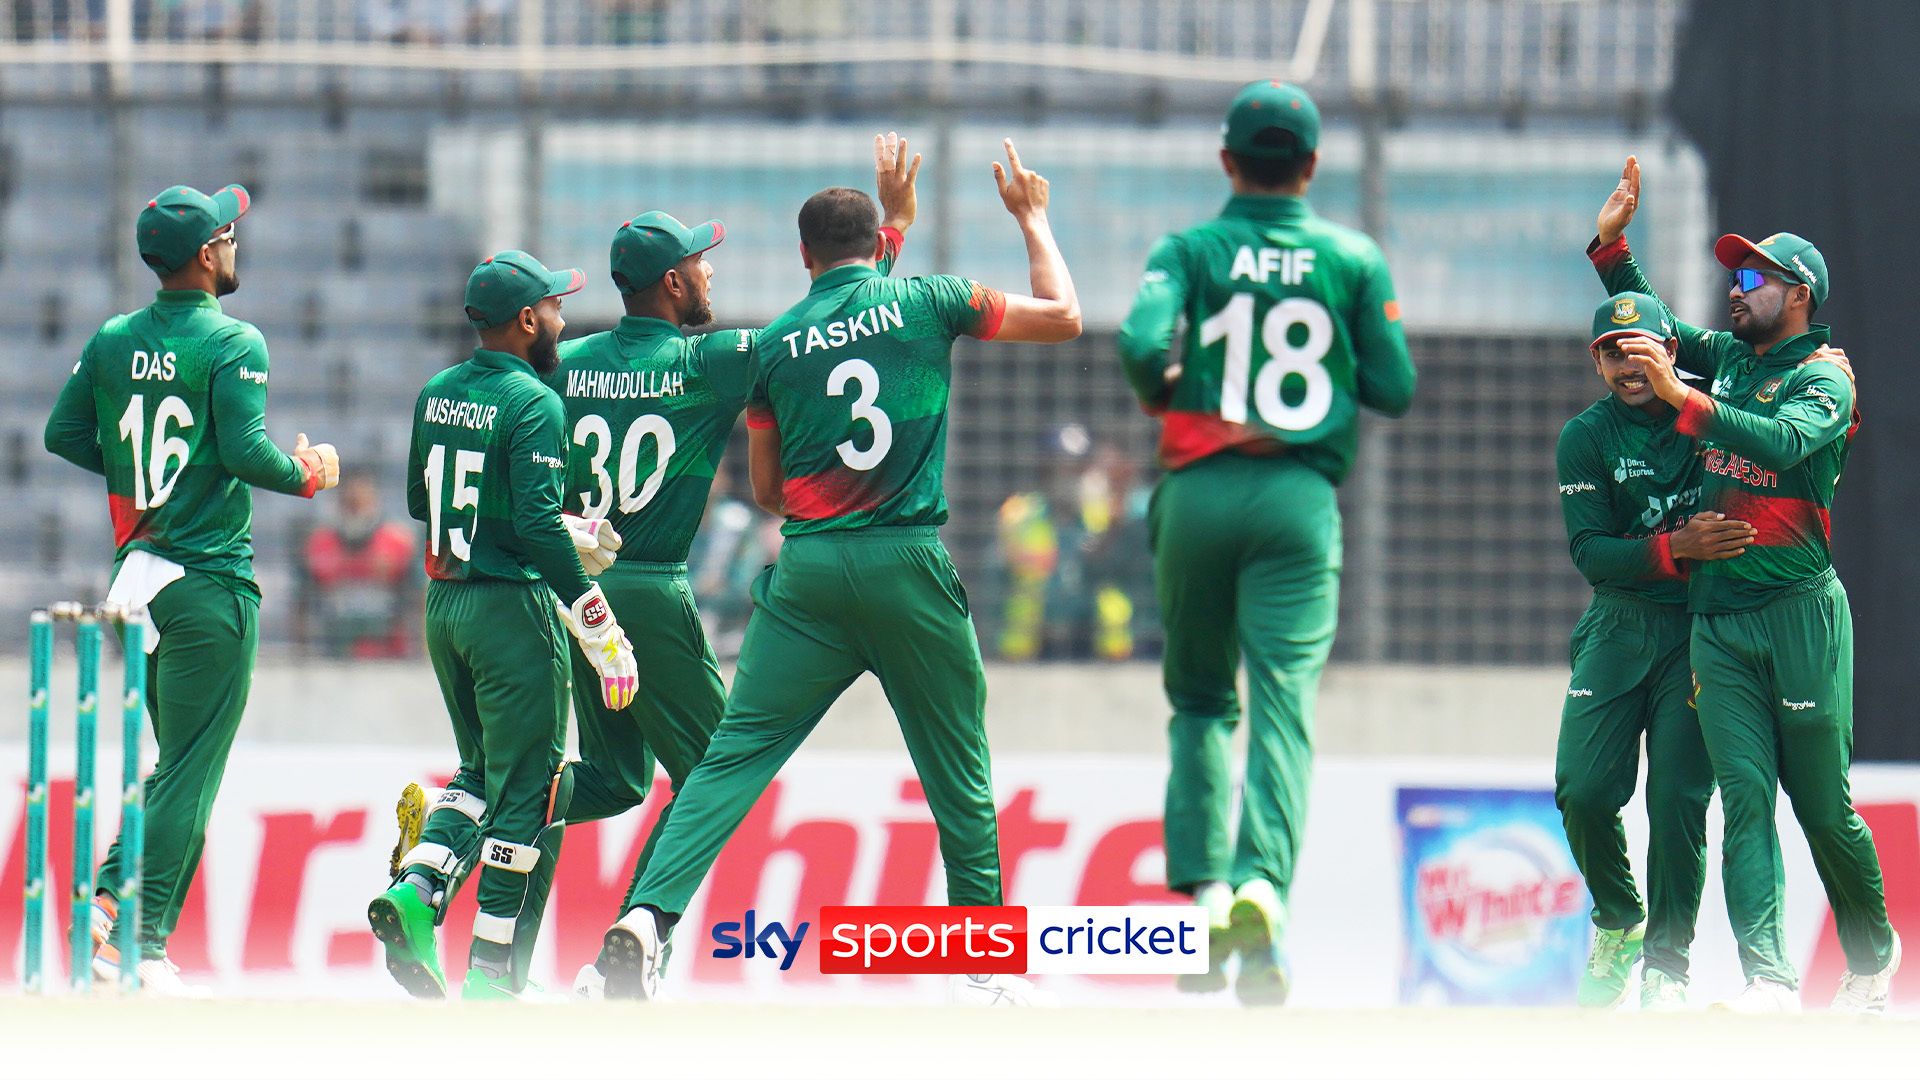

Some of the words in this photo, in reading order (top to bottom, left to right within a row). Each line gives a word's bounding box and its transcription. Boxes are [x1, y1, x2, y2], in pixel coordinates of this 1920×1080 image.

[1229, 245, 1316, 285] AFIF
[782, 301, 904, 359] TASKIN
[131, 350, 177, 382] DAS
[566, 370, 685, 399] MAHMUDULLAH
[1200, 291, 1334, 431] 18
[424, 396, 498, 431] MUSHFIQUR
[826, 358, 893, 471] 3
[118, 394, 194, 511] 16
[573, 414, 676, 520] 30
[424, 444, 486, 562] 15
[584, 602, 606, 622] SS
[490, 844, 514, 865] SS
